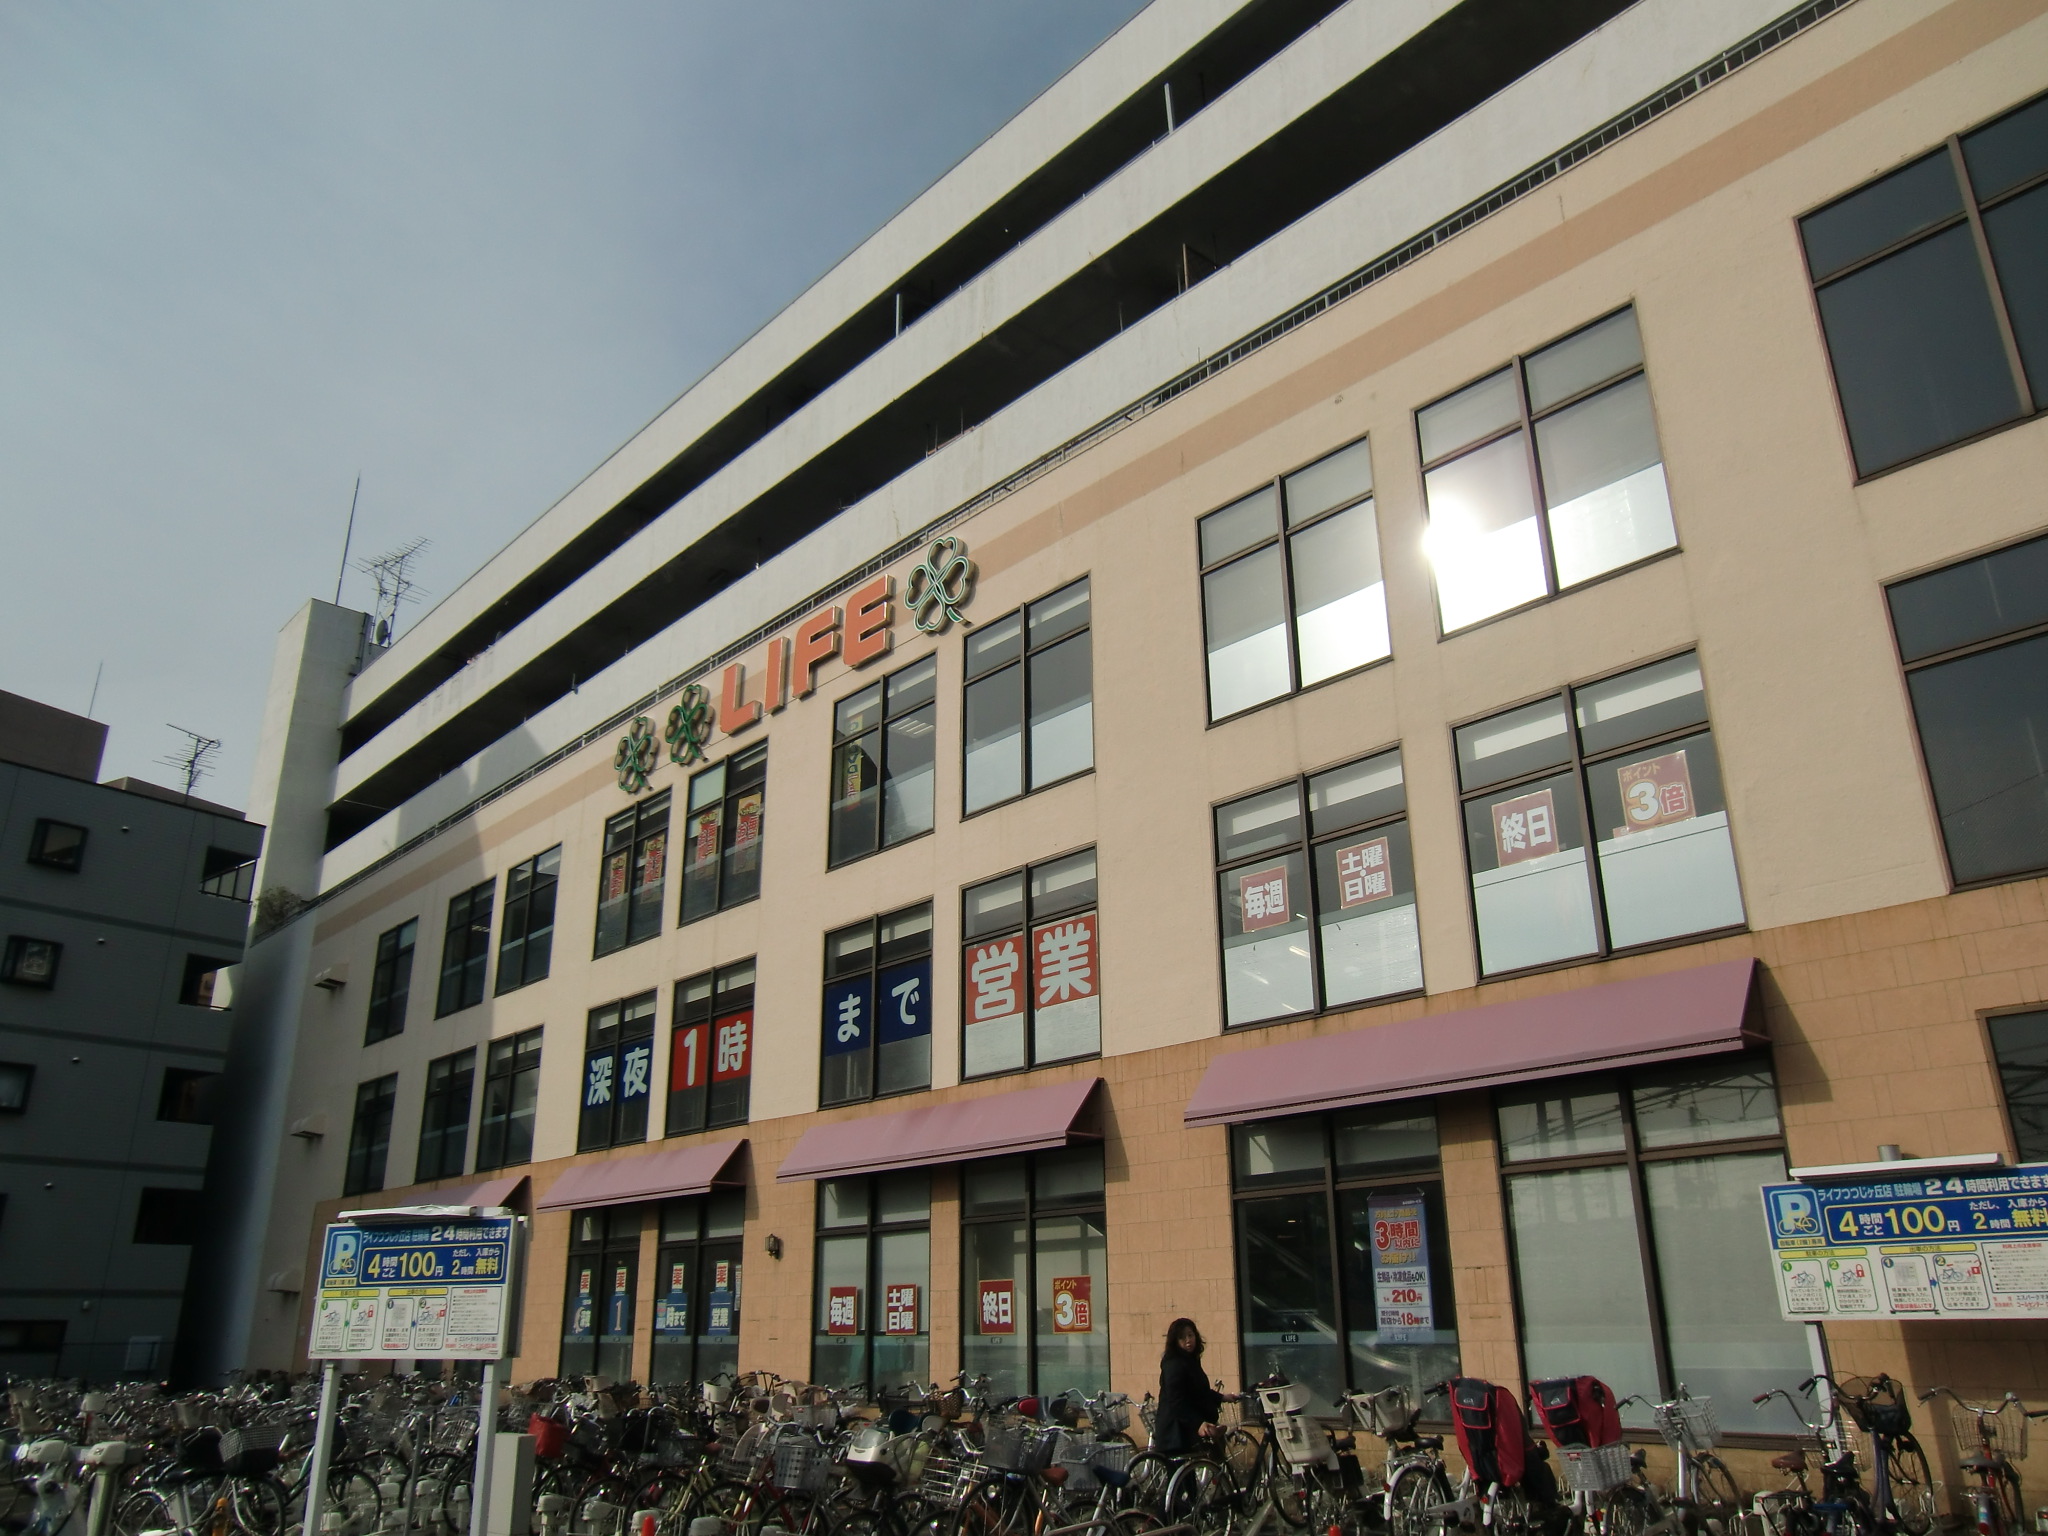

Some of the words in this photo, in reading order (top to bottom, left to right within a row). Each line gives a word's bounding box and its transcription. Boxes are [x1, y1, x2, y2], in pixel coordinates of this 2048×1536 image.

[720, 574, 894, 734] LIFE
[1628, 782, 1688, 821] 3倍
[1500, 805, 1552, 854] 終日
[1244, 878, 1286, 919] 毎週
[587, 1047, 650, 1106] 深夜
[684, 1020, 748, 1087] 1時
[837, 977, 920, 1043] まで
[971, 922, 1092, 1020] 営業
[1375, 1220, 1419, 1250] 3時間
[1839, 1211, 1859, 1236] 4
[1859, 1213, 1883, 1225] 時間
[1863, 1225, 1884, 1236] ごと
[367, 1253, 380, 1278] 4
[382, 1256, 398, 1267] 時間
[382, 1268, 396, 1277] ごと
[1054, 1279, 1077, 1290] ポイント
[711, 1307, 729, 1327] 営業
[830, 1295, 854, 1326] 毎週
[982, 1291, 1012, 1325] 終日
[1056, 1293, 1089, 1326] 3倍
